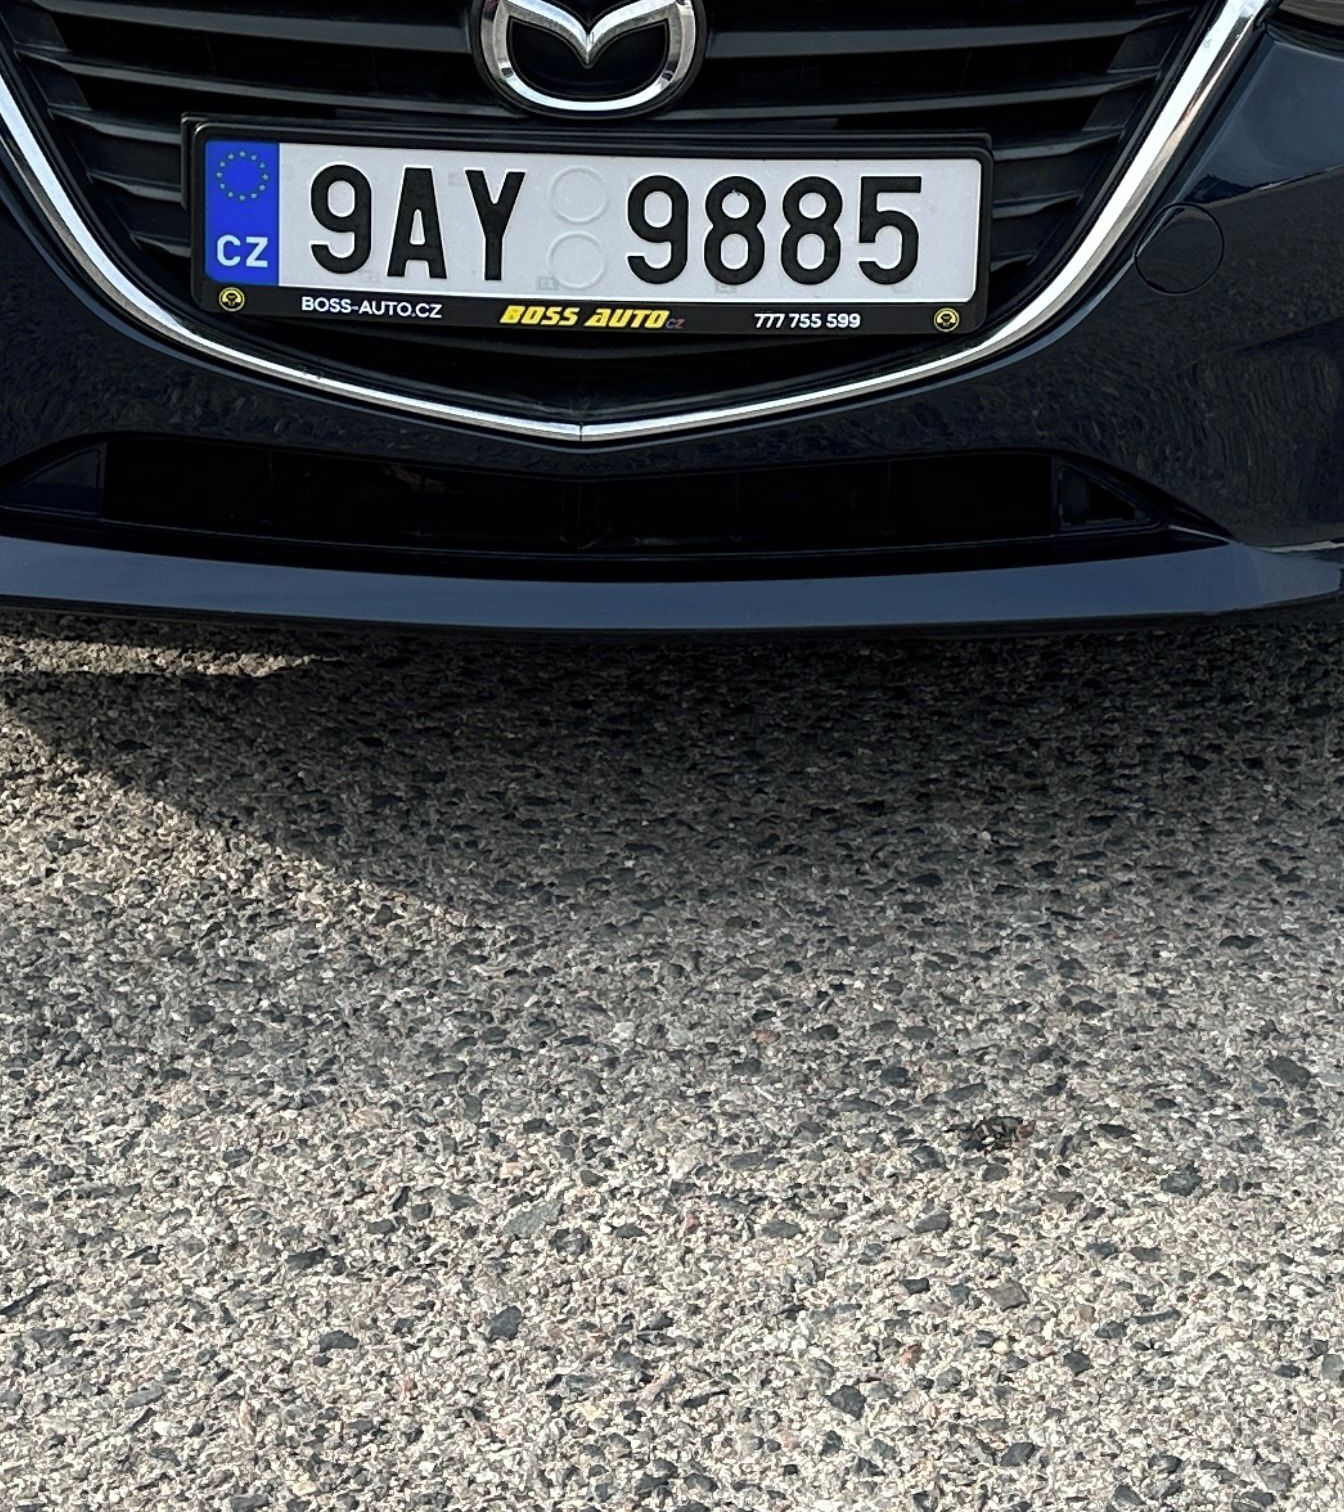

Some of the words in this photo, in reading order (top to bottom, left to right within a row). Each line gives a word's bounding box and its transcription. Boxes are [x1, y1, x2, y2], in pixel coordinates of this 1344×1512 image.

[216, 234, 269, 269] CZ
[310, 164, 526, 282] 9AY
[626, 174, 923, 286] 9885
[301, 296, 443, 319] BOSS-AUTO.CZ
[500, 304, 580, 326] BOSS
[584, 307, 670, 329] AUTO
[754, 313, 784, 328] 777
[790, 313, 822, 328] 755
[826, 313, 861, 328] 599
